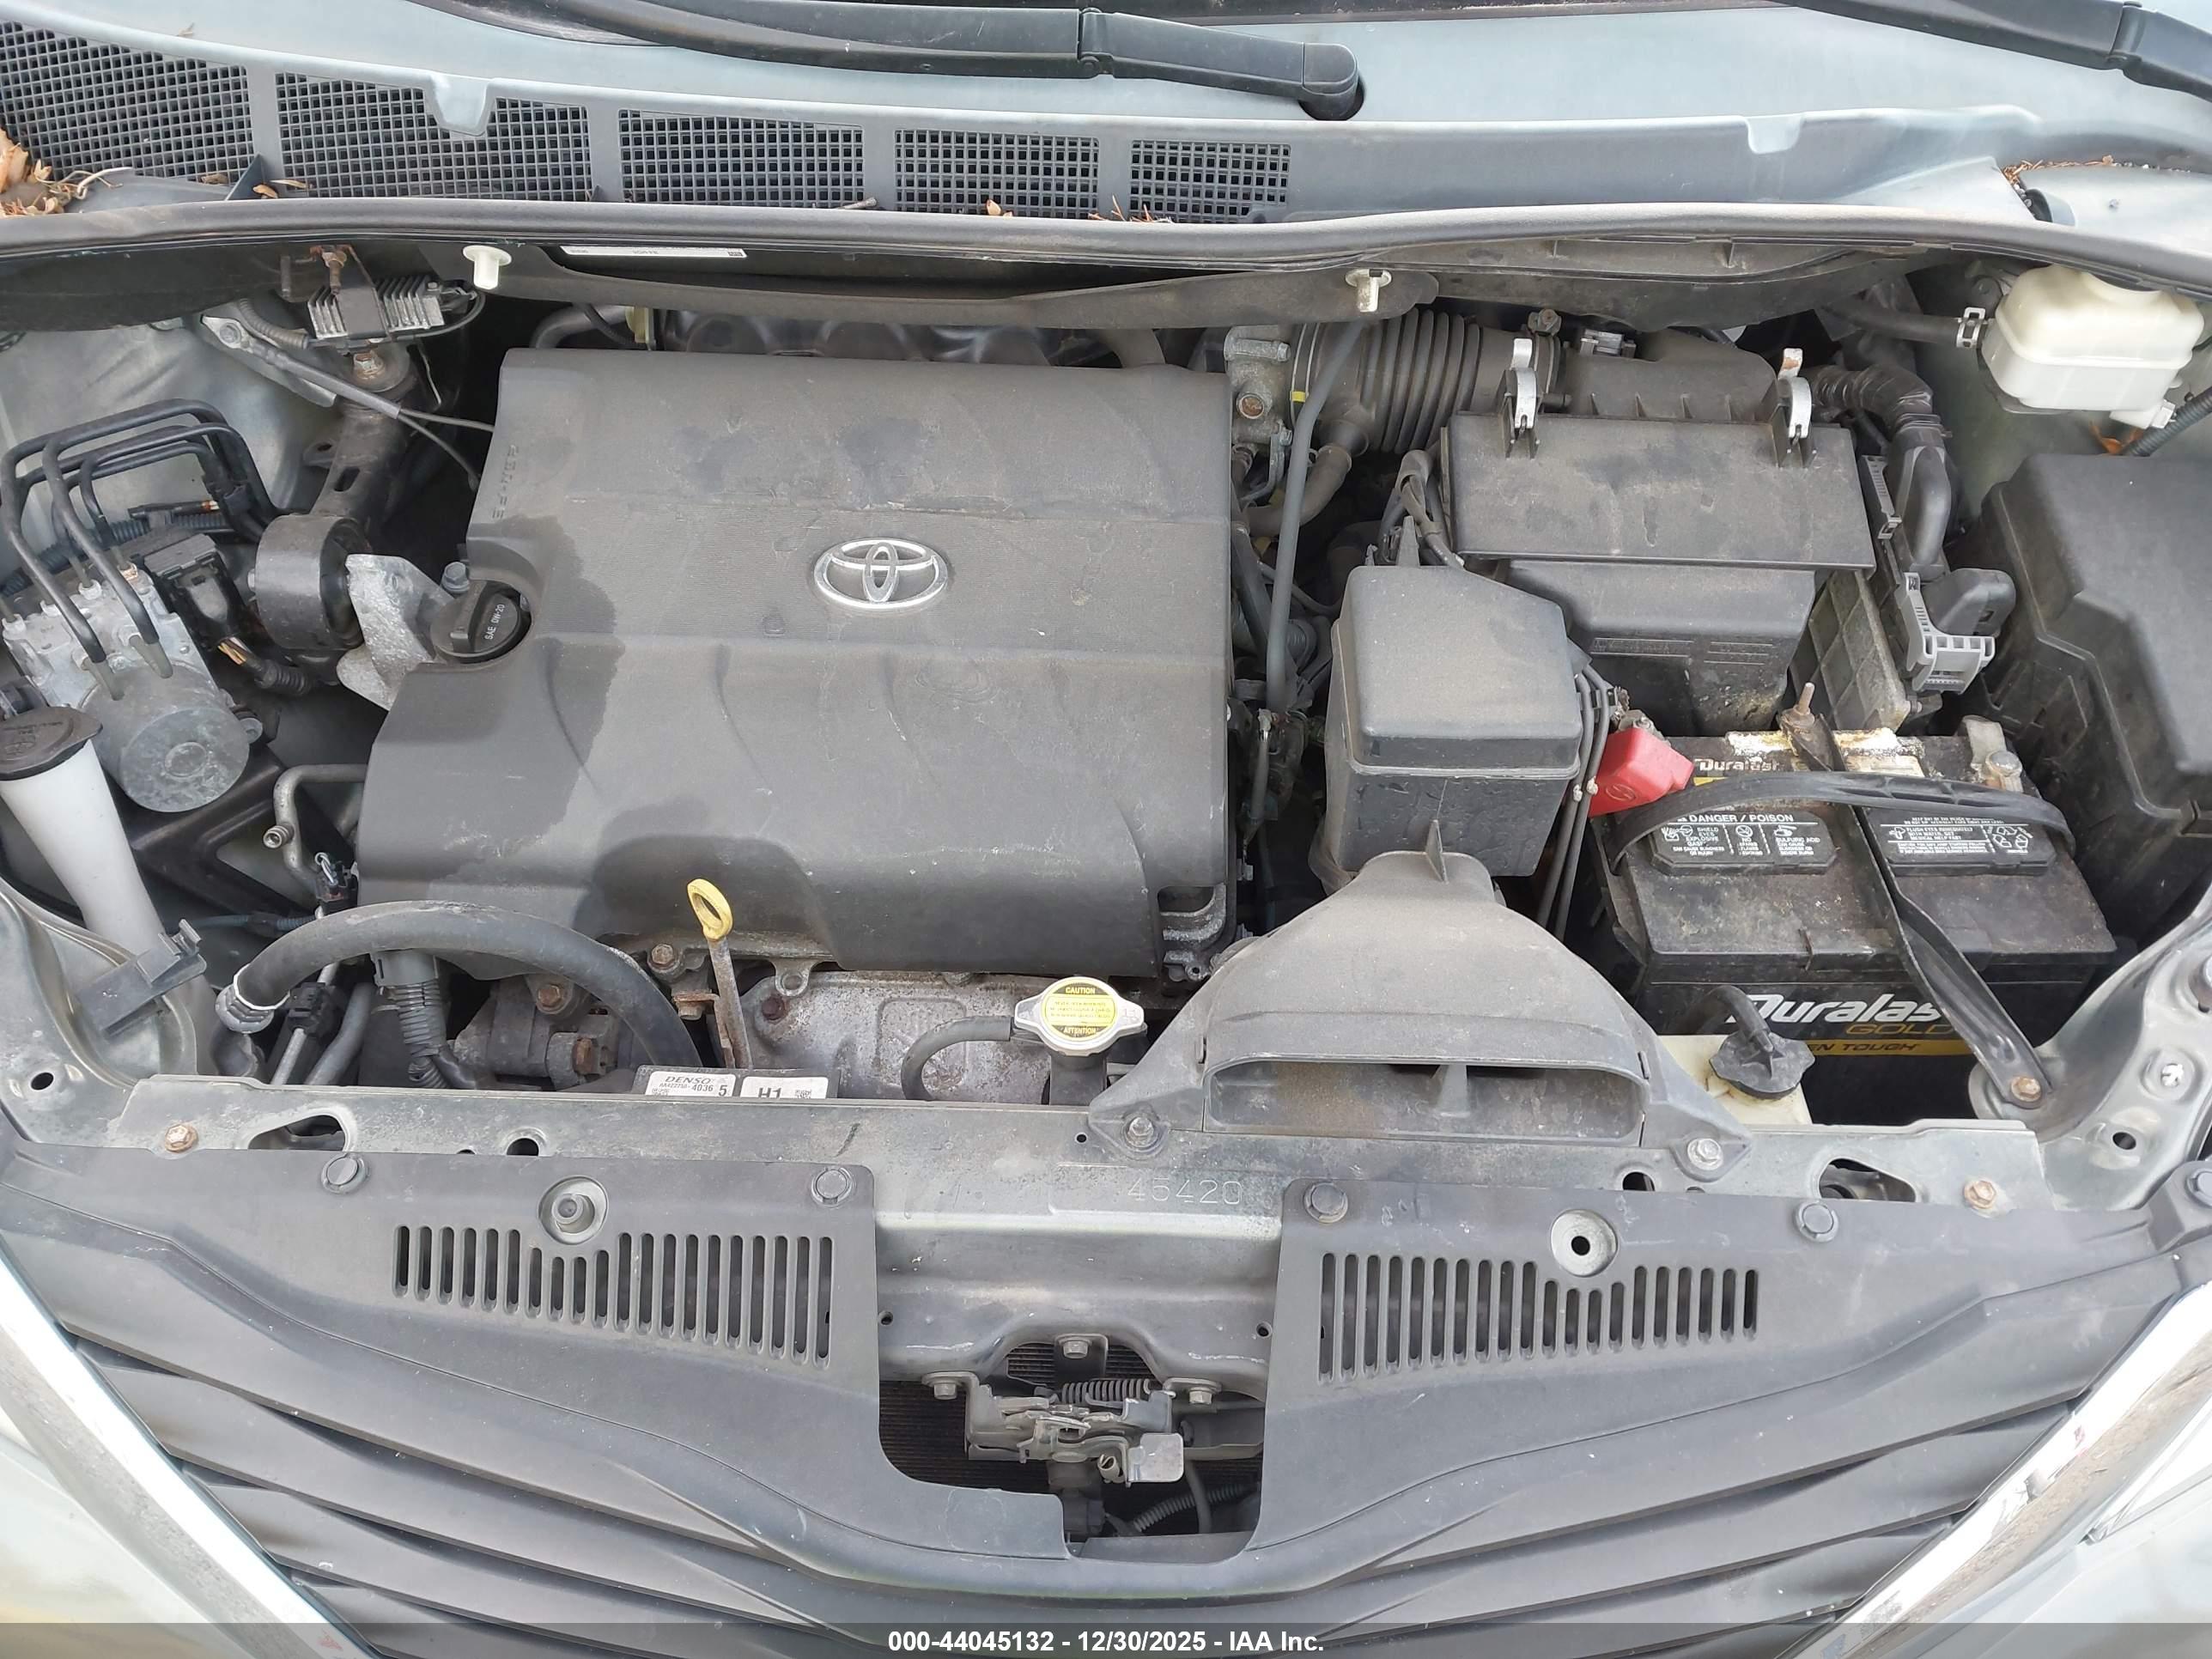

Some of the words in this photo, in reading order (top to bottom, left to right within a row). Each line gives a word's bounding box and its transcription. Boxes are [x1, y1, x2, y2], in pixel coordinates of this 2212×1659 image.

[490, 603, 506, 624] 0W-20
[484, 624, 497, 641] SAE
[1694, 757, 1780, 771] Duralast
[1689, 814, 1737, 823] DANGER
[1749, 814, 1794, 823] POISON
[1723, 994, 1942, 1024] Duralas
[1063, 1026, 1097, 1035] ATTENTION
[1845, 1024, 1953, 1036] GOLD
[665, 1076, 712, 1085] DENSO
[758, 1087, 781, 1099] H1
